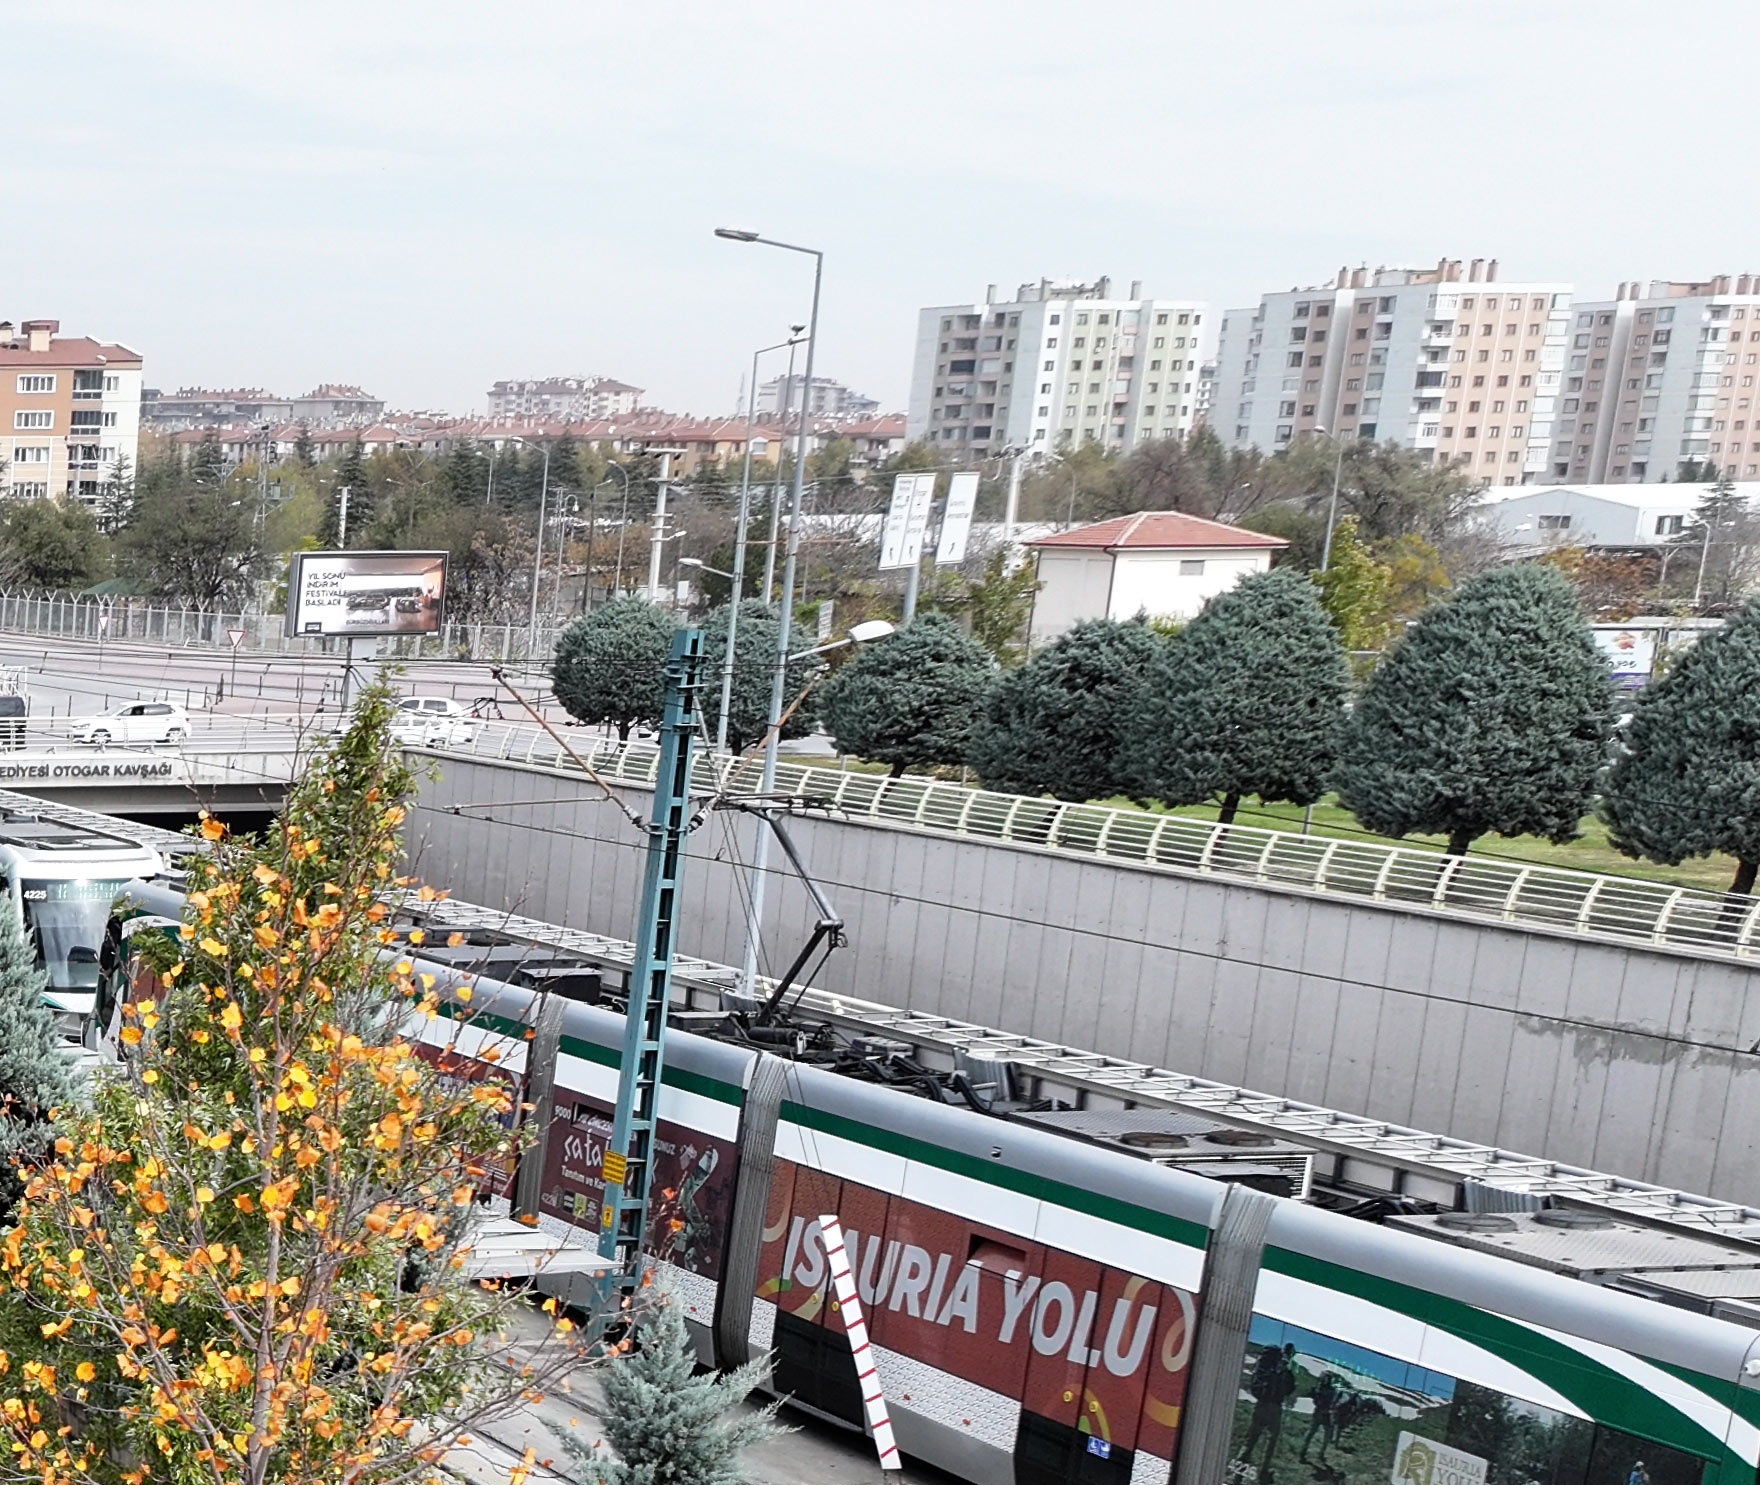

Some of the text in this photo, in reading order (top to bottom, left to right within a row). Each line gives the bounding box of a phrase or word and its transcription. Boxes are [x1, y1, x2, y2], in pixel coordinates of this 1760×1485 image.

[53, 765, 110, 778] OTOGAR
[113, 763, 172, 779] KAVŞAĞI
[23, 889, 48, 900] 4225
[554, 1104, 572, 1121] 9000
[782, 1216, 1157, 1377] ISAURIA YOLU
